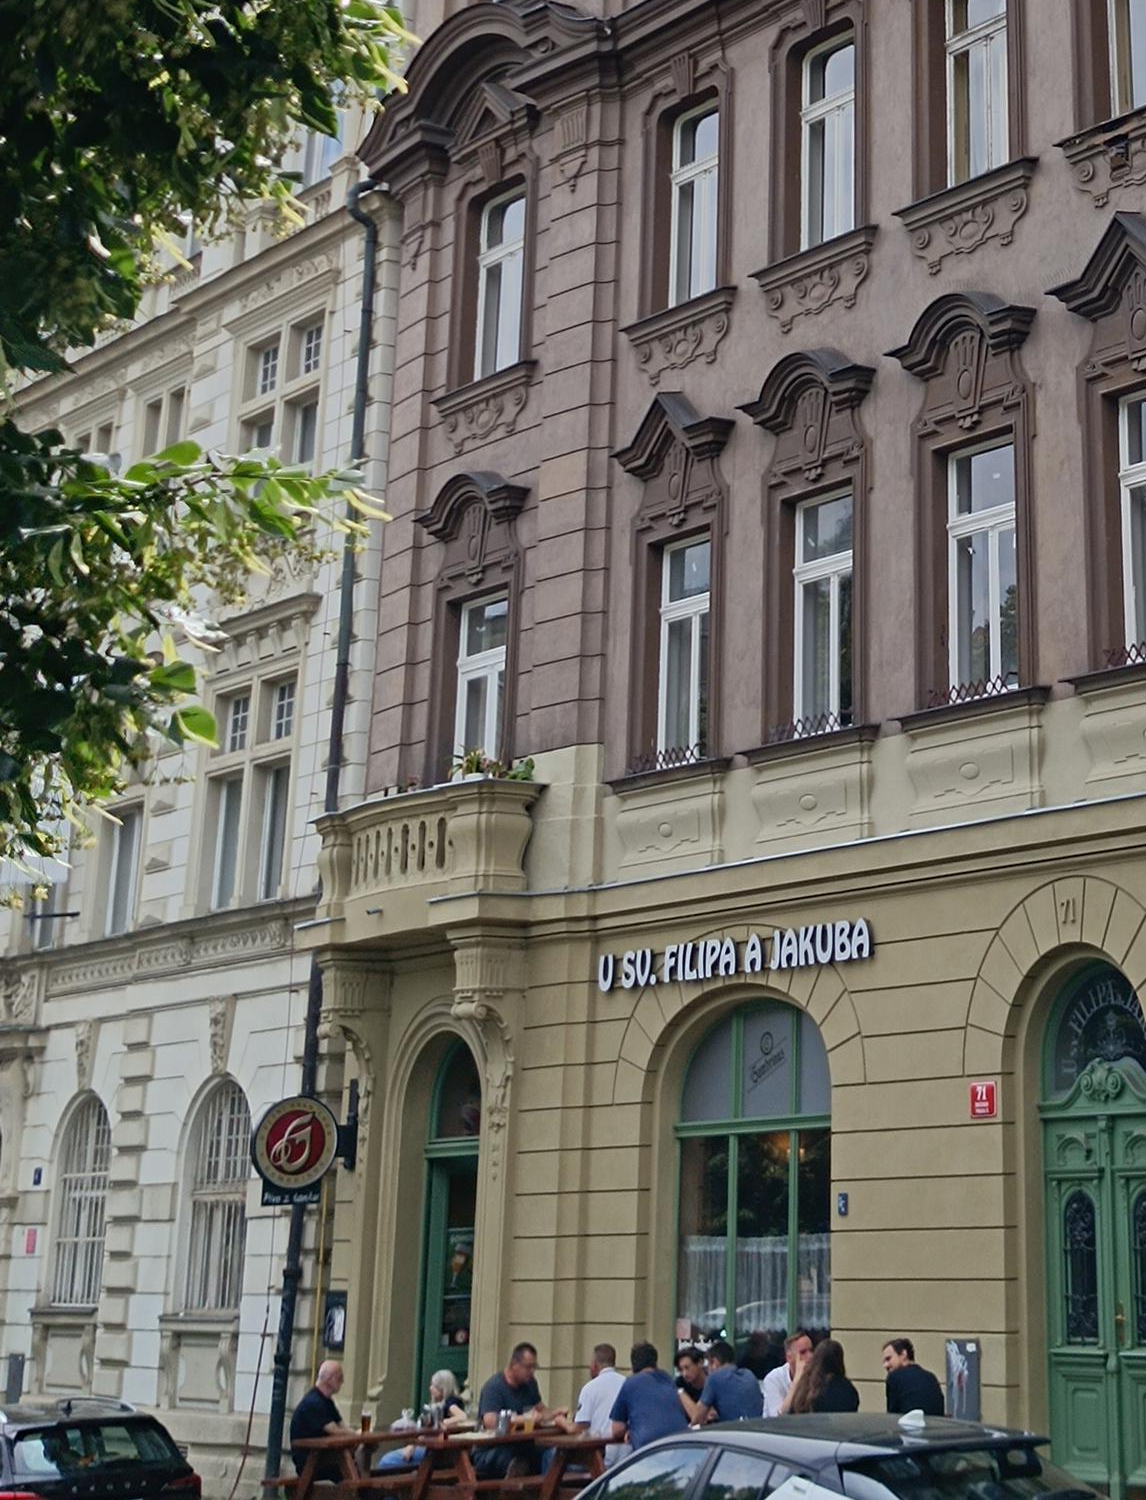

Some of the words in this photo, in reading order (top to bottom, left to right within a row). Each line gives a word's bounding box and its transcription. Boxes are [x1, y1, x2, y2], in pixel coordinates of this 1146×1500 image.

[1060, 898, 1077, 925] 71
[598, 954, 614, 993] U
[621, 948, 657, 989] SV.
[663, 936, 737, 983] FILIPA
[744, 932, 763, 973] A
[770, 916, 872, 971] JAKUBA
[976, 1085, 987, 1101] 71
